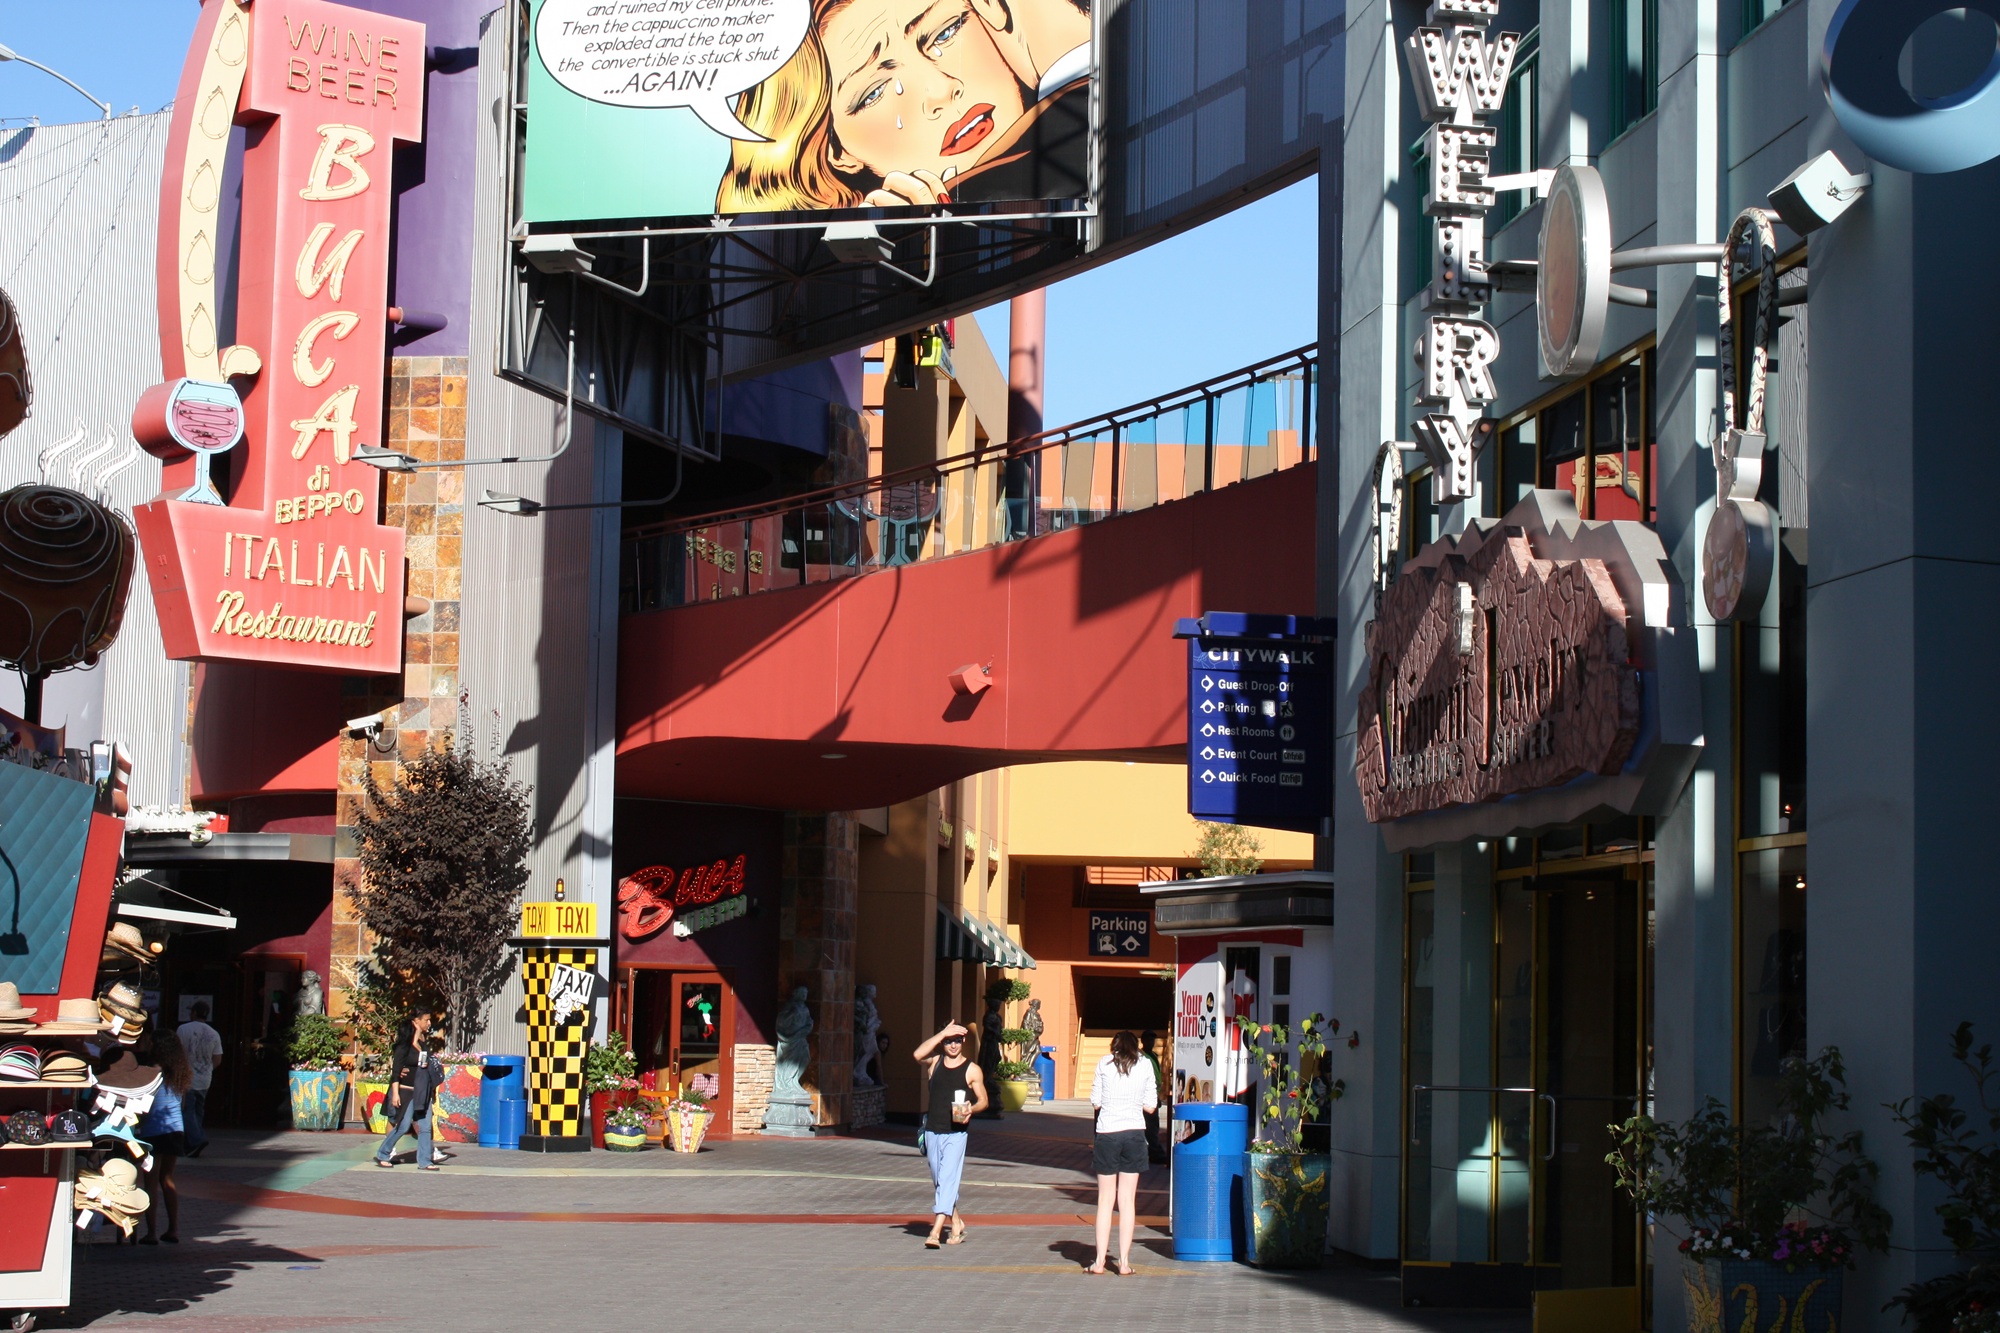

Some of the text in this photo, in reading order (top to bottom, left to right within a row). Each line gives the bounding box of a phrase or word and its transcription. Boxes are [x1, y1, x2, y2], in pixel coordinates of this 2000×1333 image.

[586, 0, 618, 17] and
[617, 0, 668, 15] ruined
[669, 0, 692, 14] my
[562, 10, 775, 36] Then the cappuccino maker
[284, 15, 400, 73] WINE
[584, 30, 765, 54] exploded and the top on
[558, 45, 780, 72] the convertible is stuck shut
[286, 56, 399, 109] BEER
[603, 68, 719, 94] ...AGAIN!
[1406, 0, 1520, 500] WELRY
[290, 123, 376, 465] BUCA
[307, 464, 331, 493] di
[275, 487, 365, 525] BEPPO
[223, 531, 387, 594] ITALIAN
[211, 588, 378, 649] Restaurant
[1207, 646, 1315, 665] CITYWALK
[1218, 679, 1295, 694] Guest Drop-Off
[1218, 703, 1257, 716] Parking
[1218, 725, 1275, 737] Rest Rooms
[1218, 748, 1246, 760] Event
[1250, 749, 1278, 761] Court
[1490, 720, 1555, 770] SILVER
[1218, 771, 1248, 783] Quick
[1251, 772, 1276, 784] Food
[617, 853, 747, 938] BUCA
[526, 906, 547, 933] TAXI
[556, 906, 589, 934] TAXI
[1091, 916, 1147, 934] Parking
[557, 966, 592, 997] TAXI
[1181, 990, 1203, 1016] Your
[1177, 1011, 1198, 1038] Turn
[64, 1119, 79, 1134] LA
